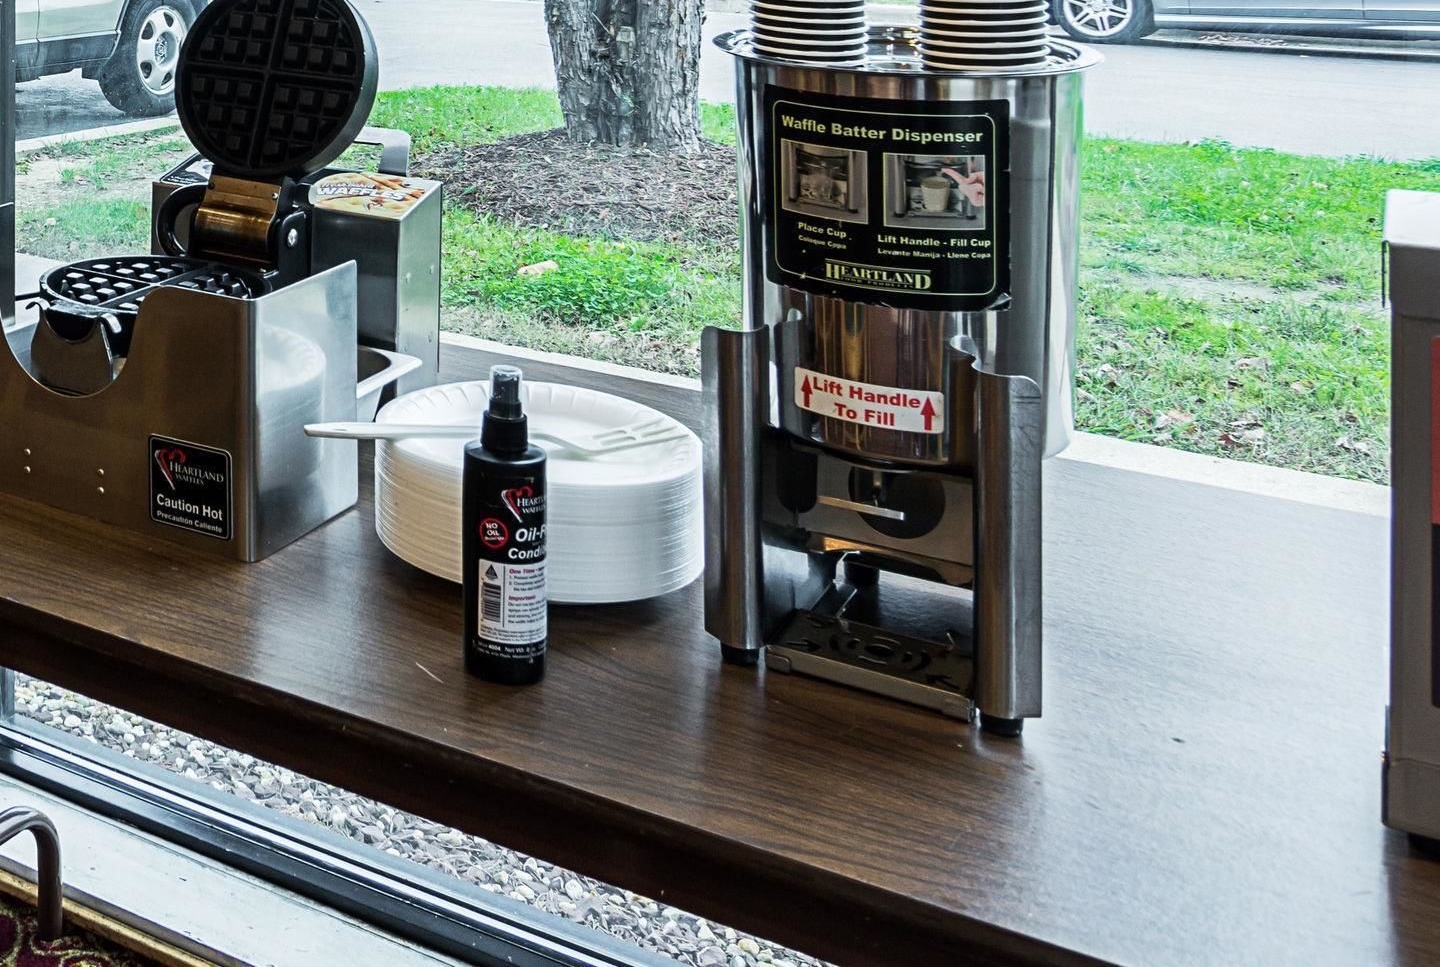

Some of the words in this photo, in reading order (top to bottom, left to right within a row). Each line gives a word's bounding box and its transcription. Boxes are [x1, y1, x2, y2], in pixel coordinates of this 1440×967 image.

[781, 114, 827, 133] Waffle
[831, 122, 887, 140] Batter
[891, 128, 985, 145] Dispenser
[317, 186, 406, 201] WAFFLES
[798, 221, 824, 234] Place
[826, 227, 847, 239] Cup
[877, 234, 897, 244] Lift
[900, 236, 940, 246] Handle
[950, 238, 967, 247] Fill
[970, 239, 991, 248] Cup
[877, 248, 911, 257] Levante
[912, 251, 940, 259] Manija
[825, 263, 932, 290] HEARTLAND
[813, 376, 843, 397] Lift
[849, 385, 921, 408] Handle
[834, 402, 858, 420] To
[864, 409, 895, 426] Fill
[169, 461, 224, 483] HEARTLAND
[175, 473, 204, 486] WAFFLES
[156, 493, 199, 515] Caution
[202, 504, 223, 521] Hot
[194, 519, 223, 534] Caliente
